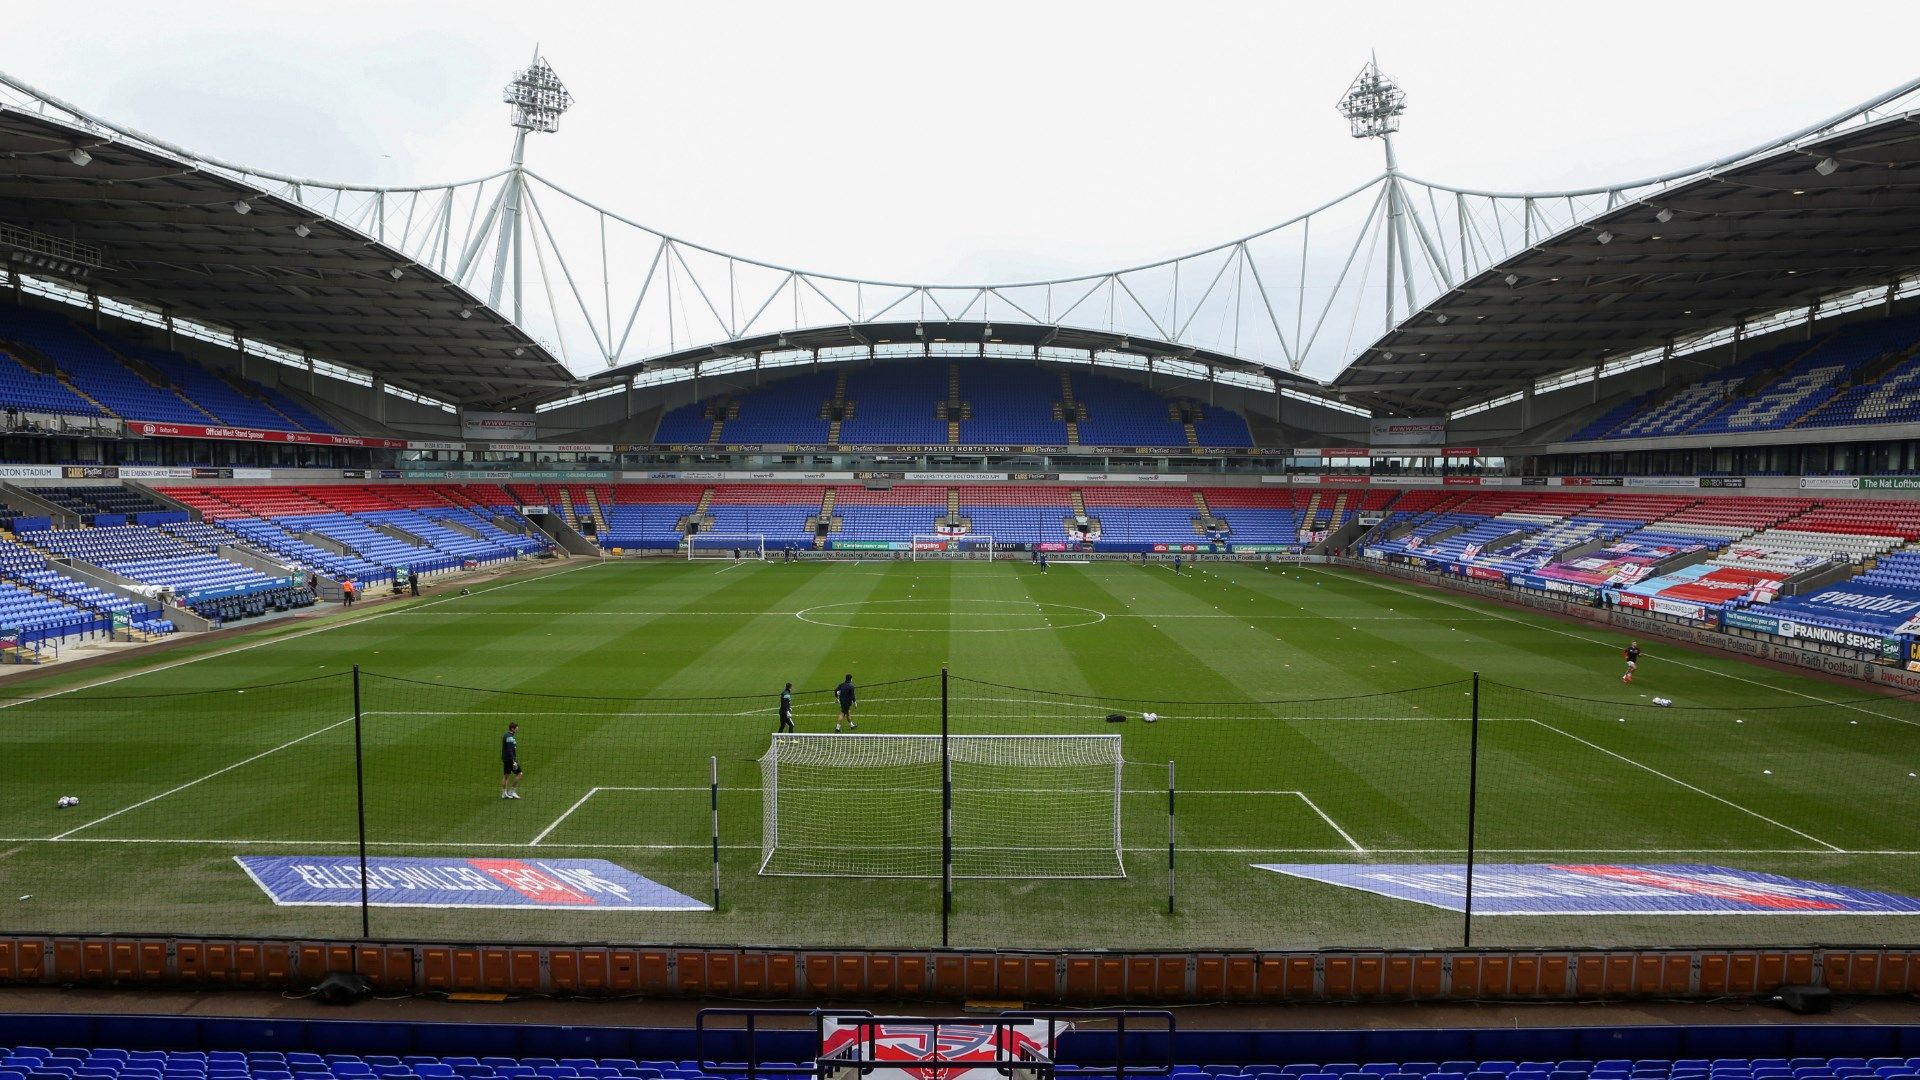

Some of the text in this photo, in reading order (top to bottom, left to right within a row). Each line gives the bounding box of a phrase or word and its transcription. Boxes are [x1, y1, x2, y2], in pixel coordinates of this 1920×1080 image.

[206, 428, 264, 439] Official West Stand Sponsor
[1865, 480, 1877, 488] The
[1879, 480, 1892, 488] Nat
[1201, 554, 1221, 562] Family
[1631, 618, 1644, 626] Heart
[1698, 632, 1726, 650] Realising
[1728, 638, 1757, 654] Potential
[1774, 650, 1799, 665] Family
[1801, 654, 1821, 668] Faith
[1823, 658, 1858, 675] Football
[1795, 624, 1844, 644] FRANKING
[1846, 632, 1882, 651] SENSE
[379, 866, 502, 891] BETTING
